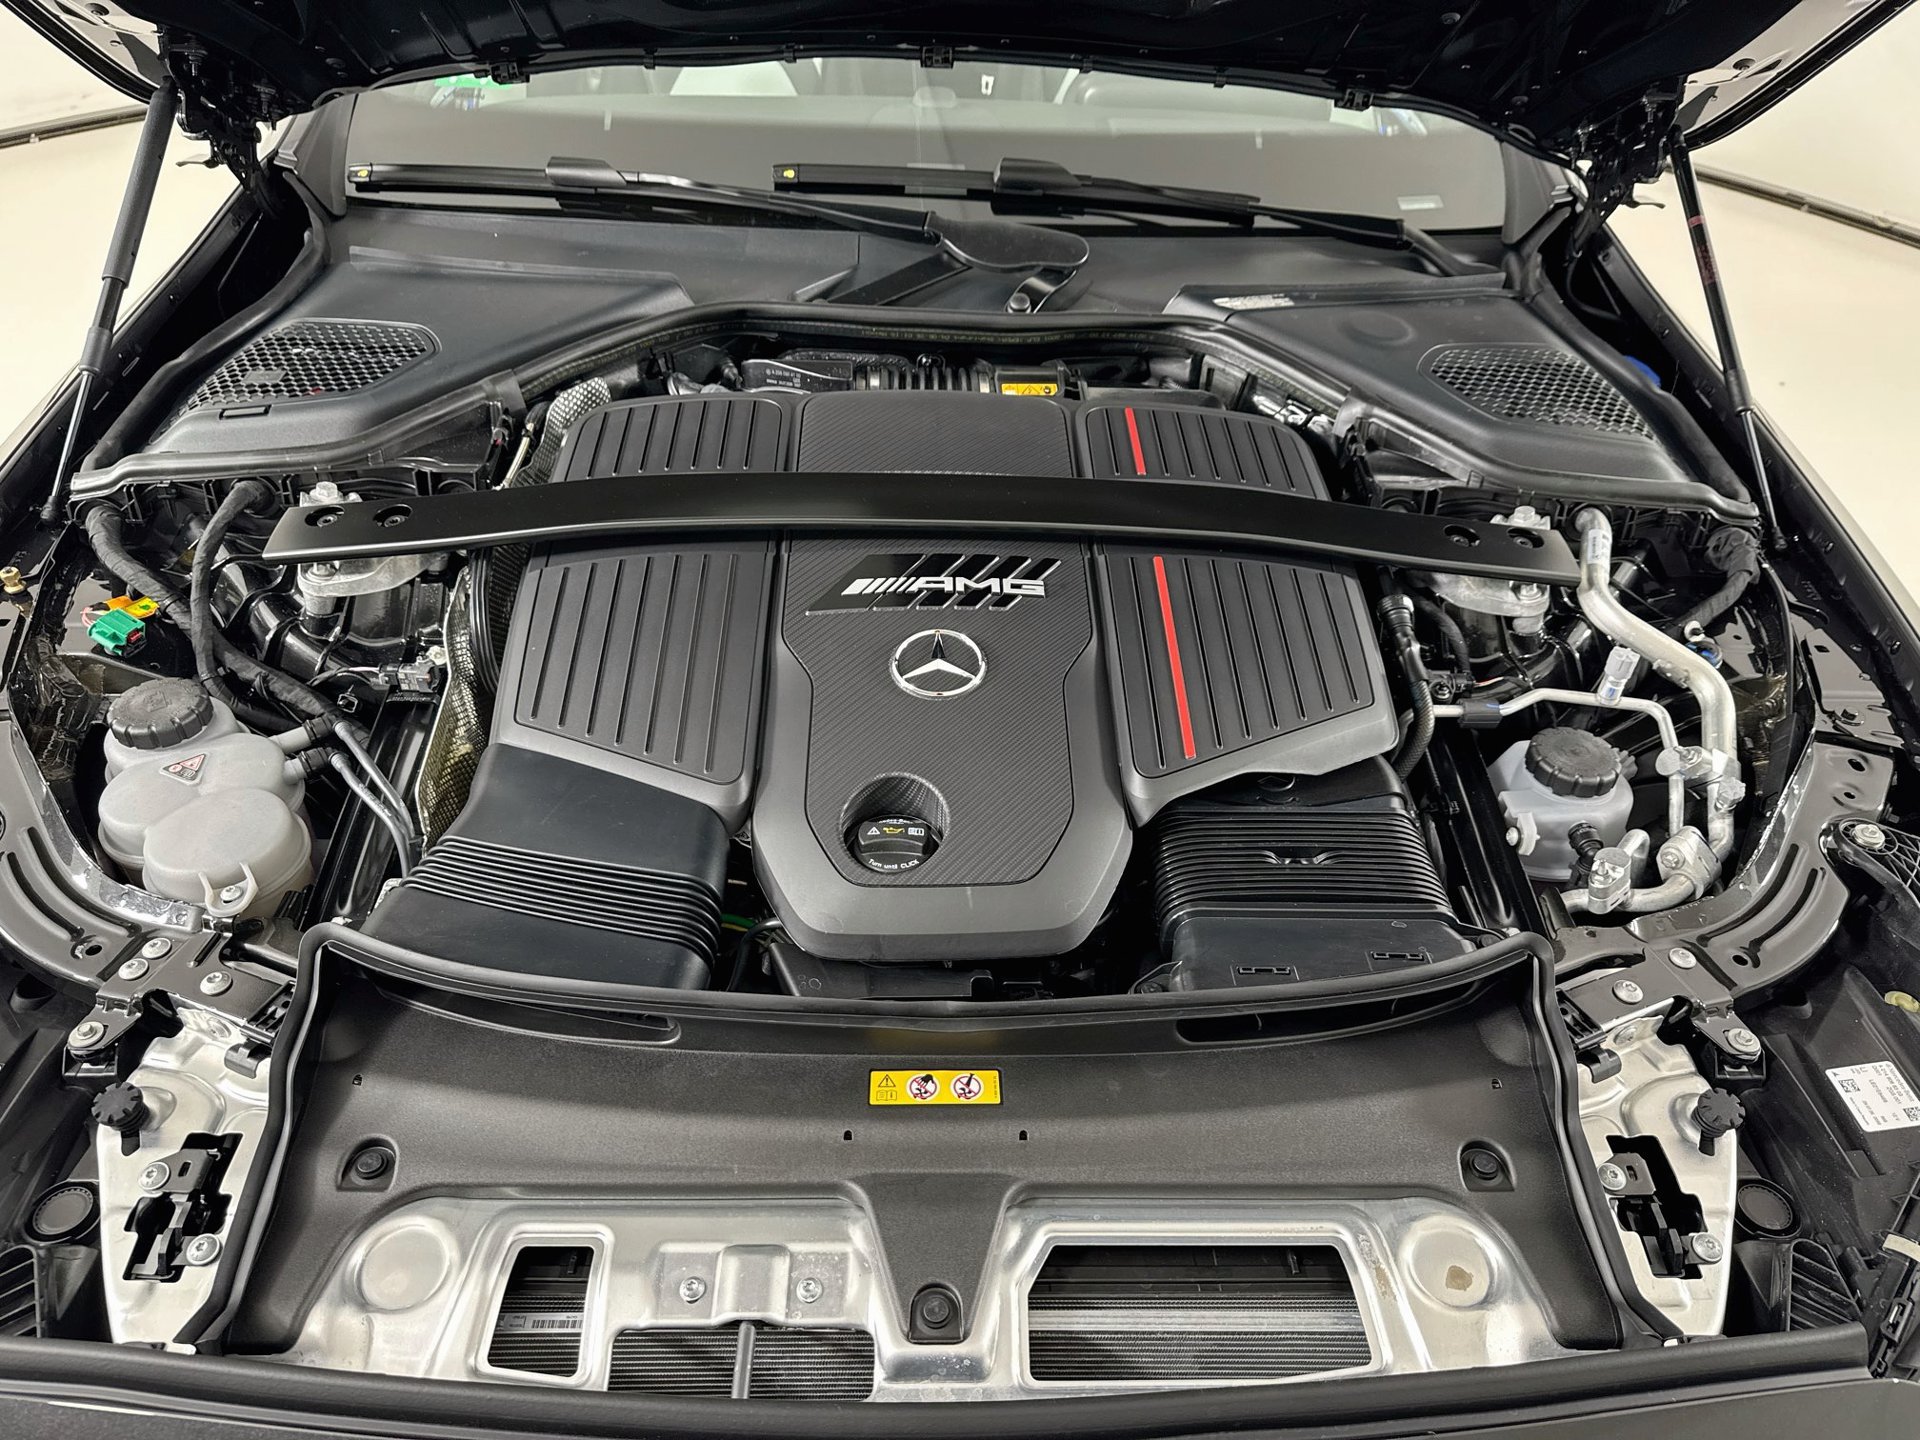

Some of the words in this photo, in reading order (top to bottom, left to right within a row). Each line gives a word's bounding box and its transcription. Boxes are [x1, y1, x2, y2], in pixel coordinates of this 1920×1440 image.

[905, 576, 1046, 599] AMG
[868, 858, 882, 868] Turn
[900, 859, 920, 869] CLICK
